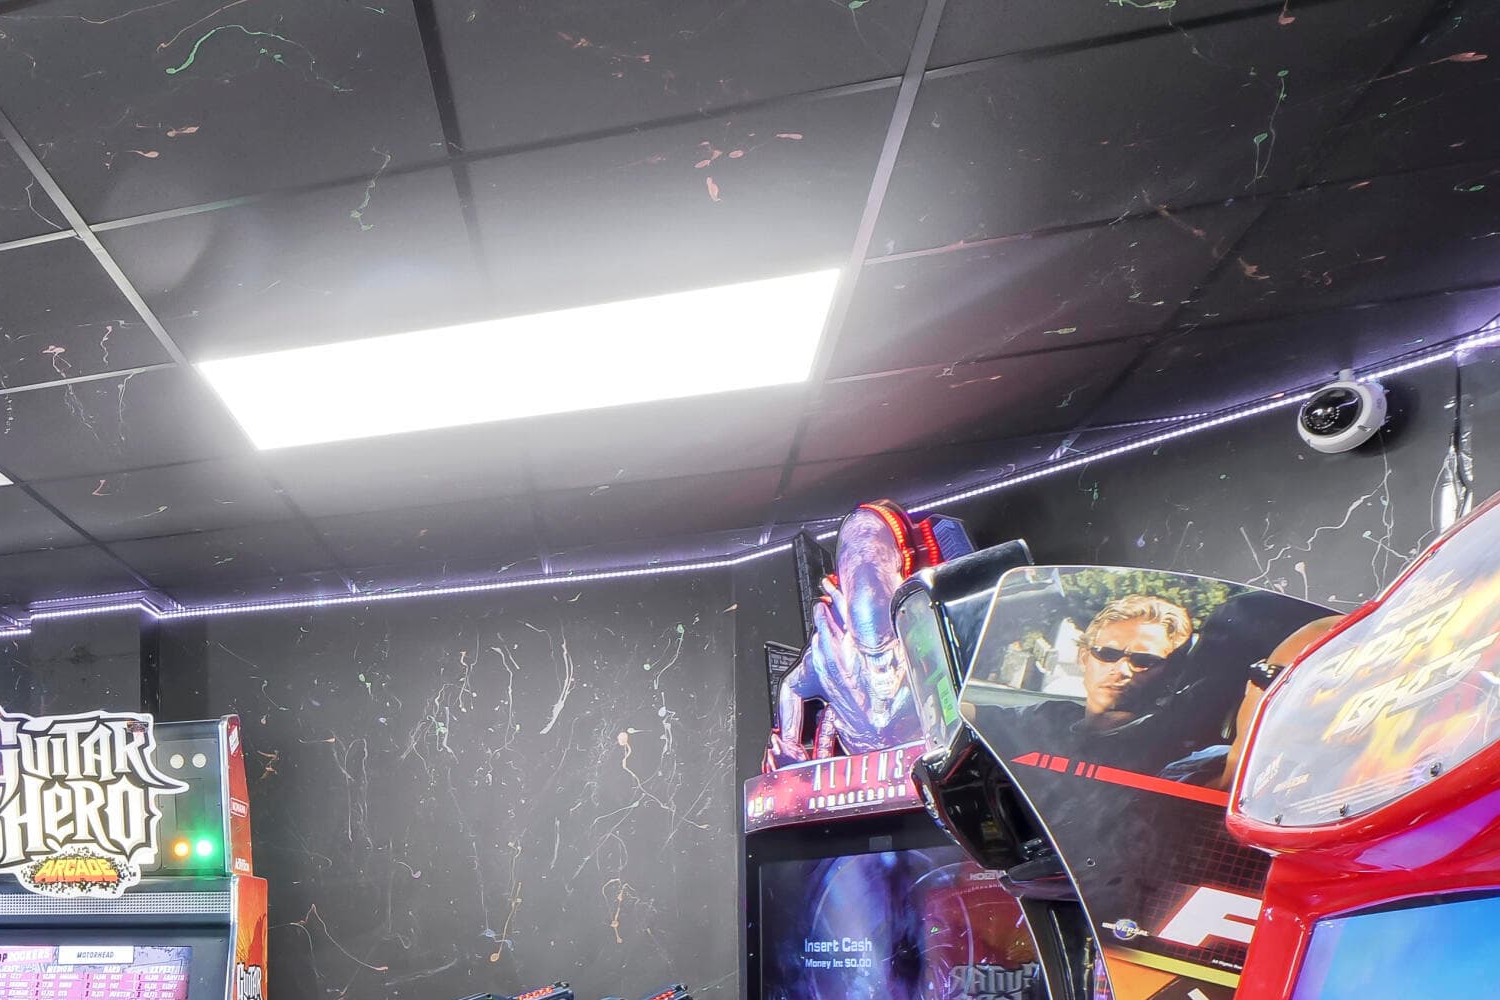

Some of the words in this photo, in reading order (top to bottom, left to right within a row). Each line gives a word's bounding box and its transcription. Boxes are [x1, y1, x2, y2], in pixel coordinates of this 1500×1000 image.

[813, 749, 904, 791] ALIENS
[808, 784, 906, 810] ARMAGEDDON
[34, 857, 120, 883] ARCADE
[76, 951, 114, 959] MOTORHEAD
[804, 938, 839, 953] Insert
[841, 937, 873, 953] Cash
[805, 958, 831, 969] Money
